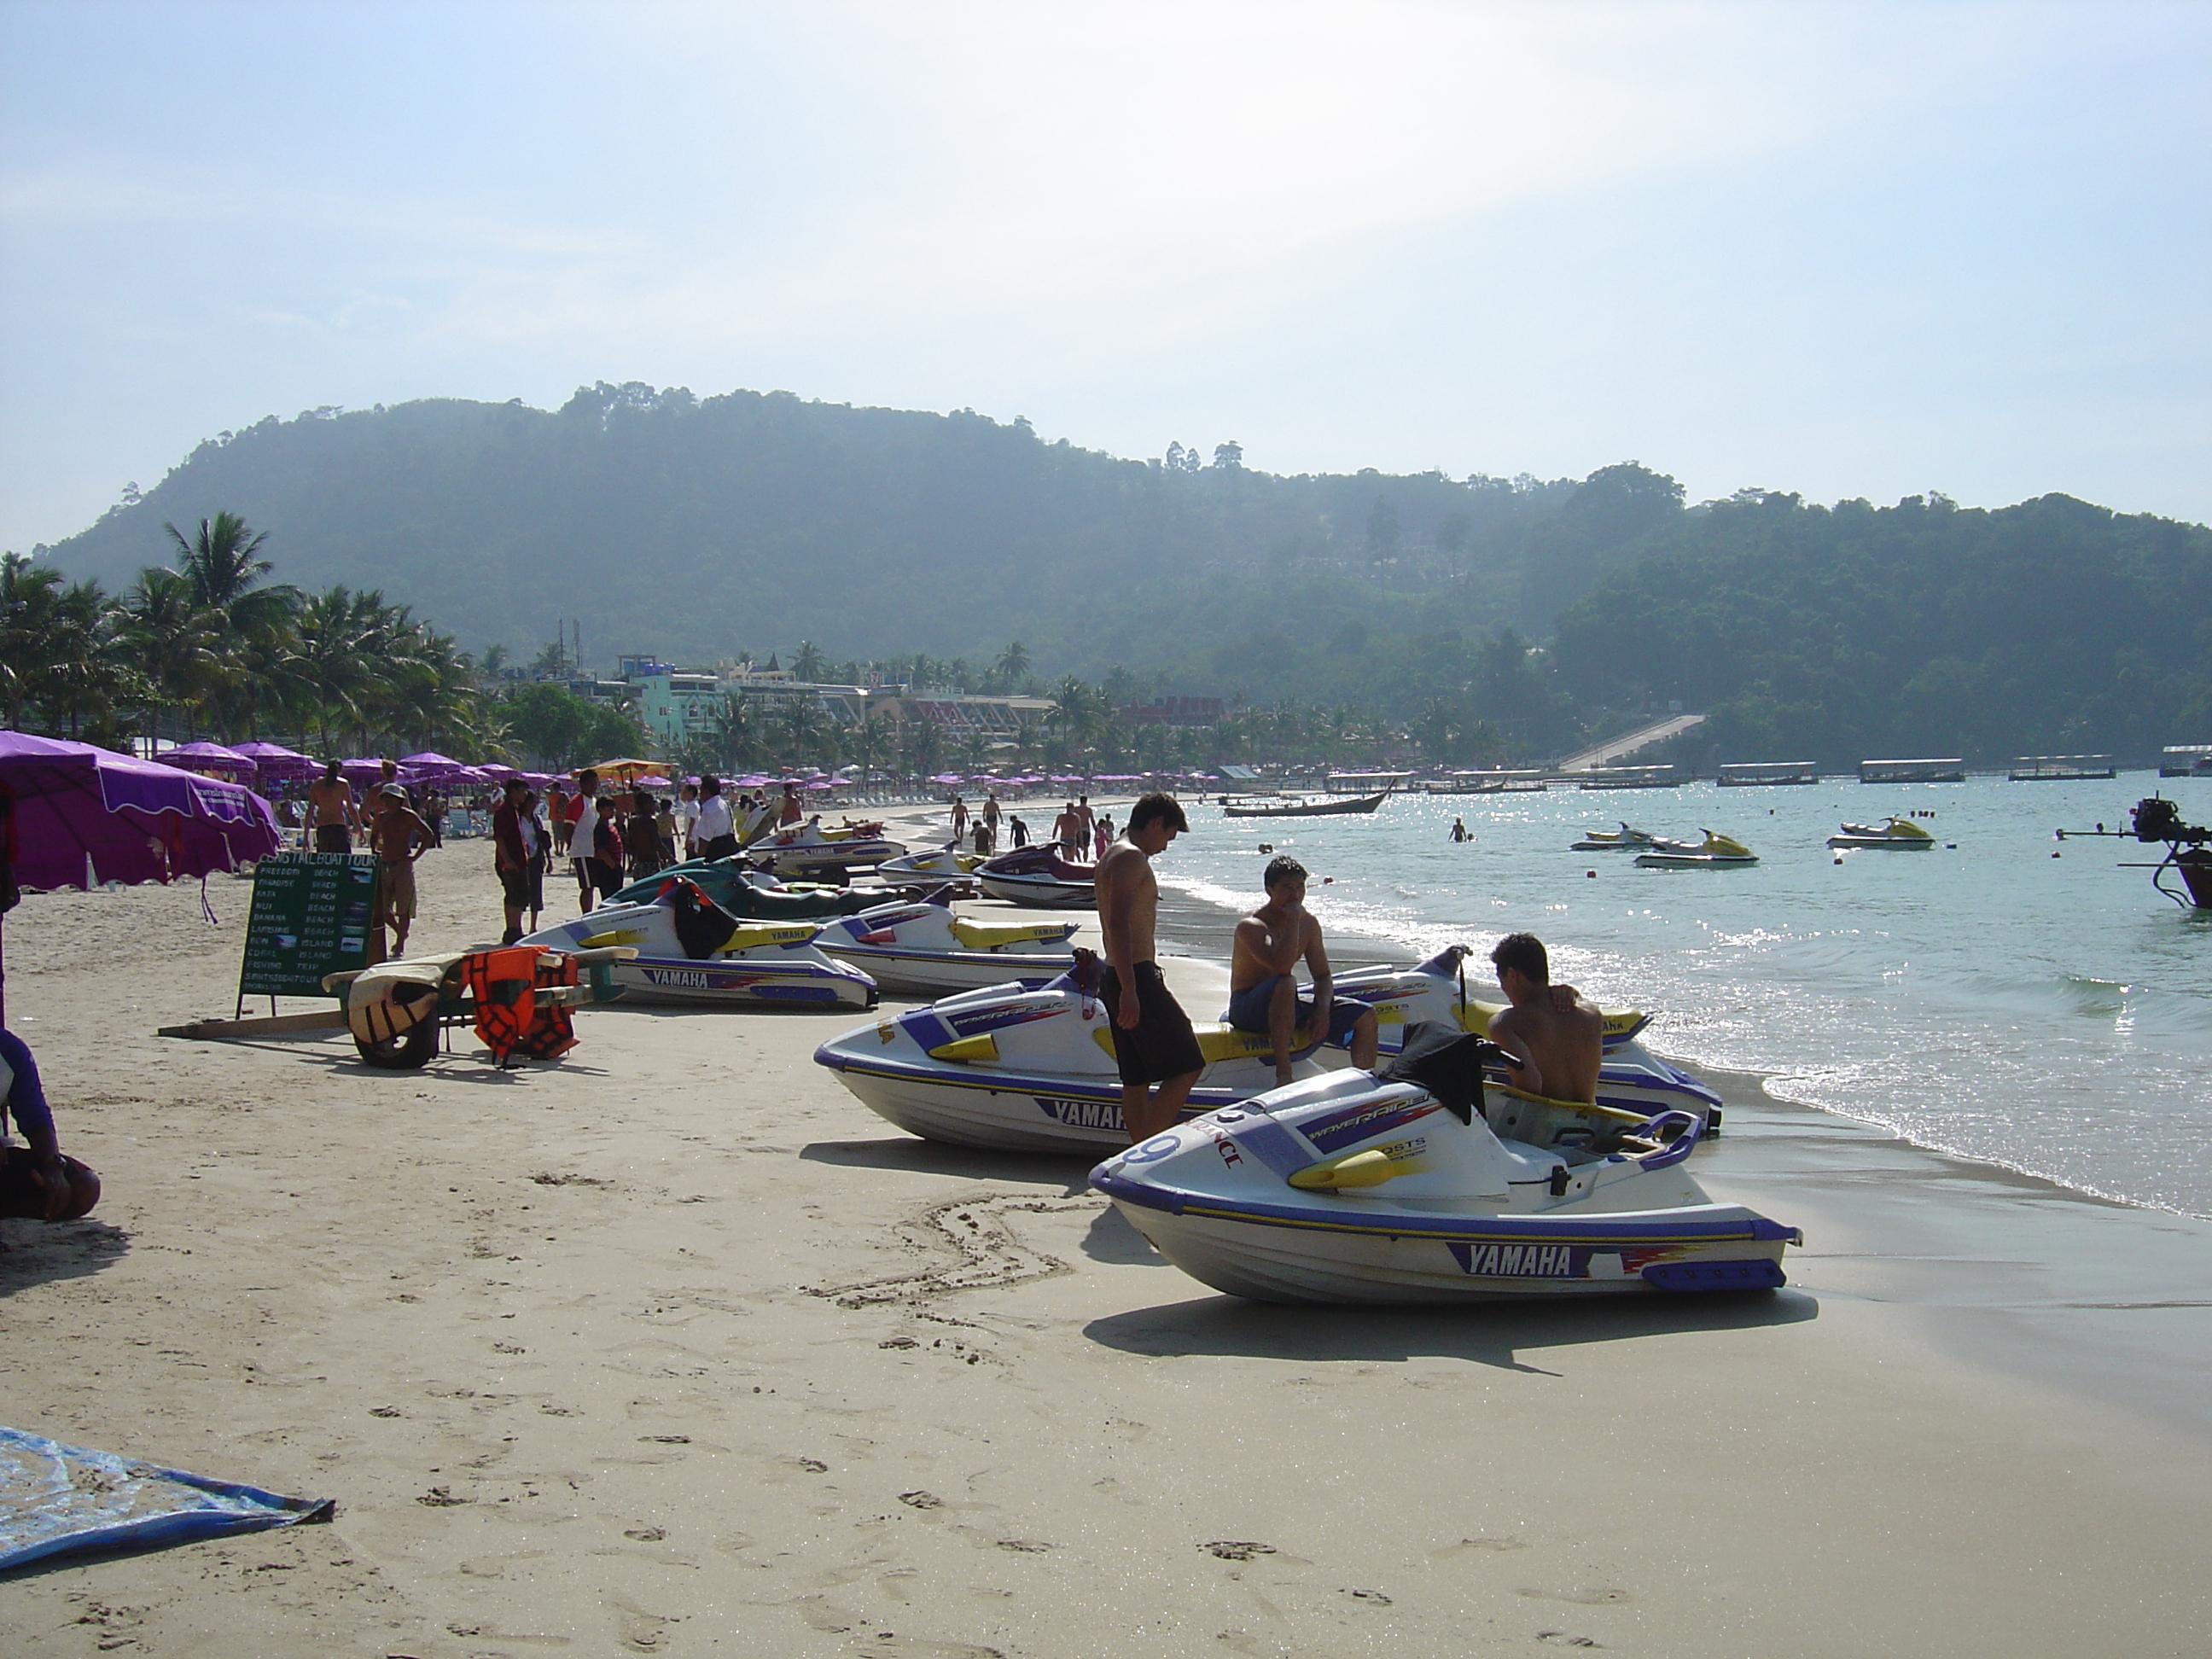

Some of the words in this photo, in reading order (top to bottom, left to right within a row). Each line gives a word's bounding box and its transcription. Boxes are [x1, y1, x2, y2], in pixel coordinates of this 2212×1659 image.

[346, 854, 376, 867] TOUR
[260, 867, 300, 876] FREEDOM
[314, 869, 339, 877] BEACH
[259, 879, 295, 888] PARADISE
[311, 881, 337, 889] BEACH
[310, 892, 336, 900] BEACH
[253, 913, 287, 922] BANANA
[771, 929, 806, 940] YAMAHA
[1033, 927, 1064, 936] YAMAHA
[301, 939, 334, 947] ISLAND
[654, 970, 708, 988] YAMAHA
[1602, 1020, 1625, 1032] AHA
[1243, 1035, 1296, 1051] YAMA
[1054, 1101, 1127, 1130] YAMAH
[1470, 1244, 1570, 1276] YAMAHA
